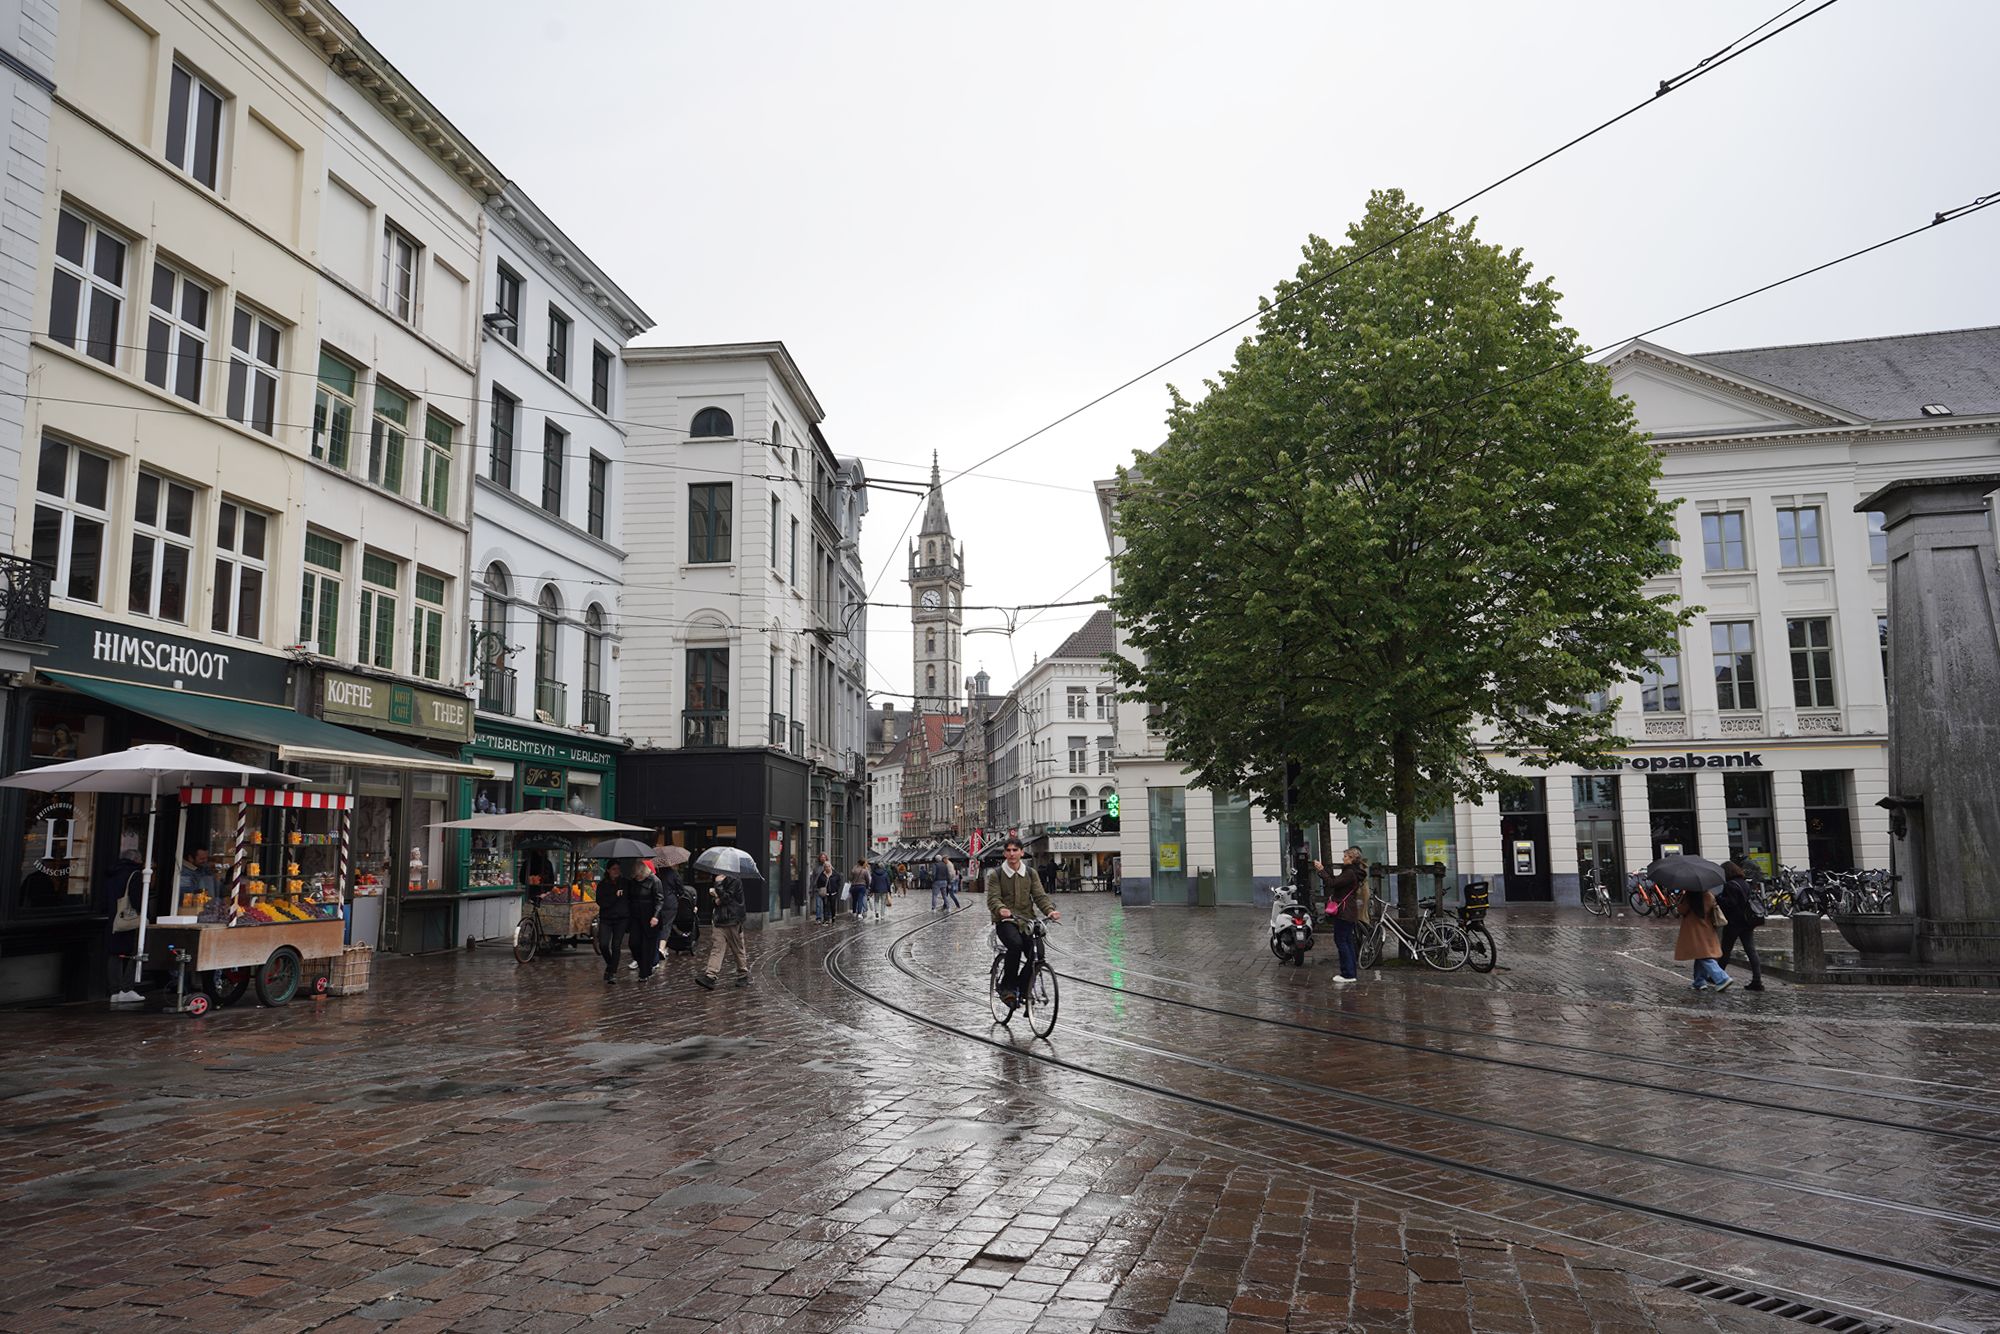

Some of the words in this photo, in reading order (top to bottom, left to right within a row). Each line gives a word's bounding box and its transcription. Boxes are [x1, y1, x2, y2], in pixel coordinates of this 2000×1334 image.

[93, 631, 229, 680] HIMSCHOOT
[327, 679, 373, 708] KOFFIE
[432, 701, 465, 726] THEE
[487, 735, 556, 757] TIERENTEYN
[570, 748, 611, 764] VERLENT
[1583, 751, 1763, 772] ropabank
[550, 771, 561, 788] 3
[41, 818, 79, 860] H
